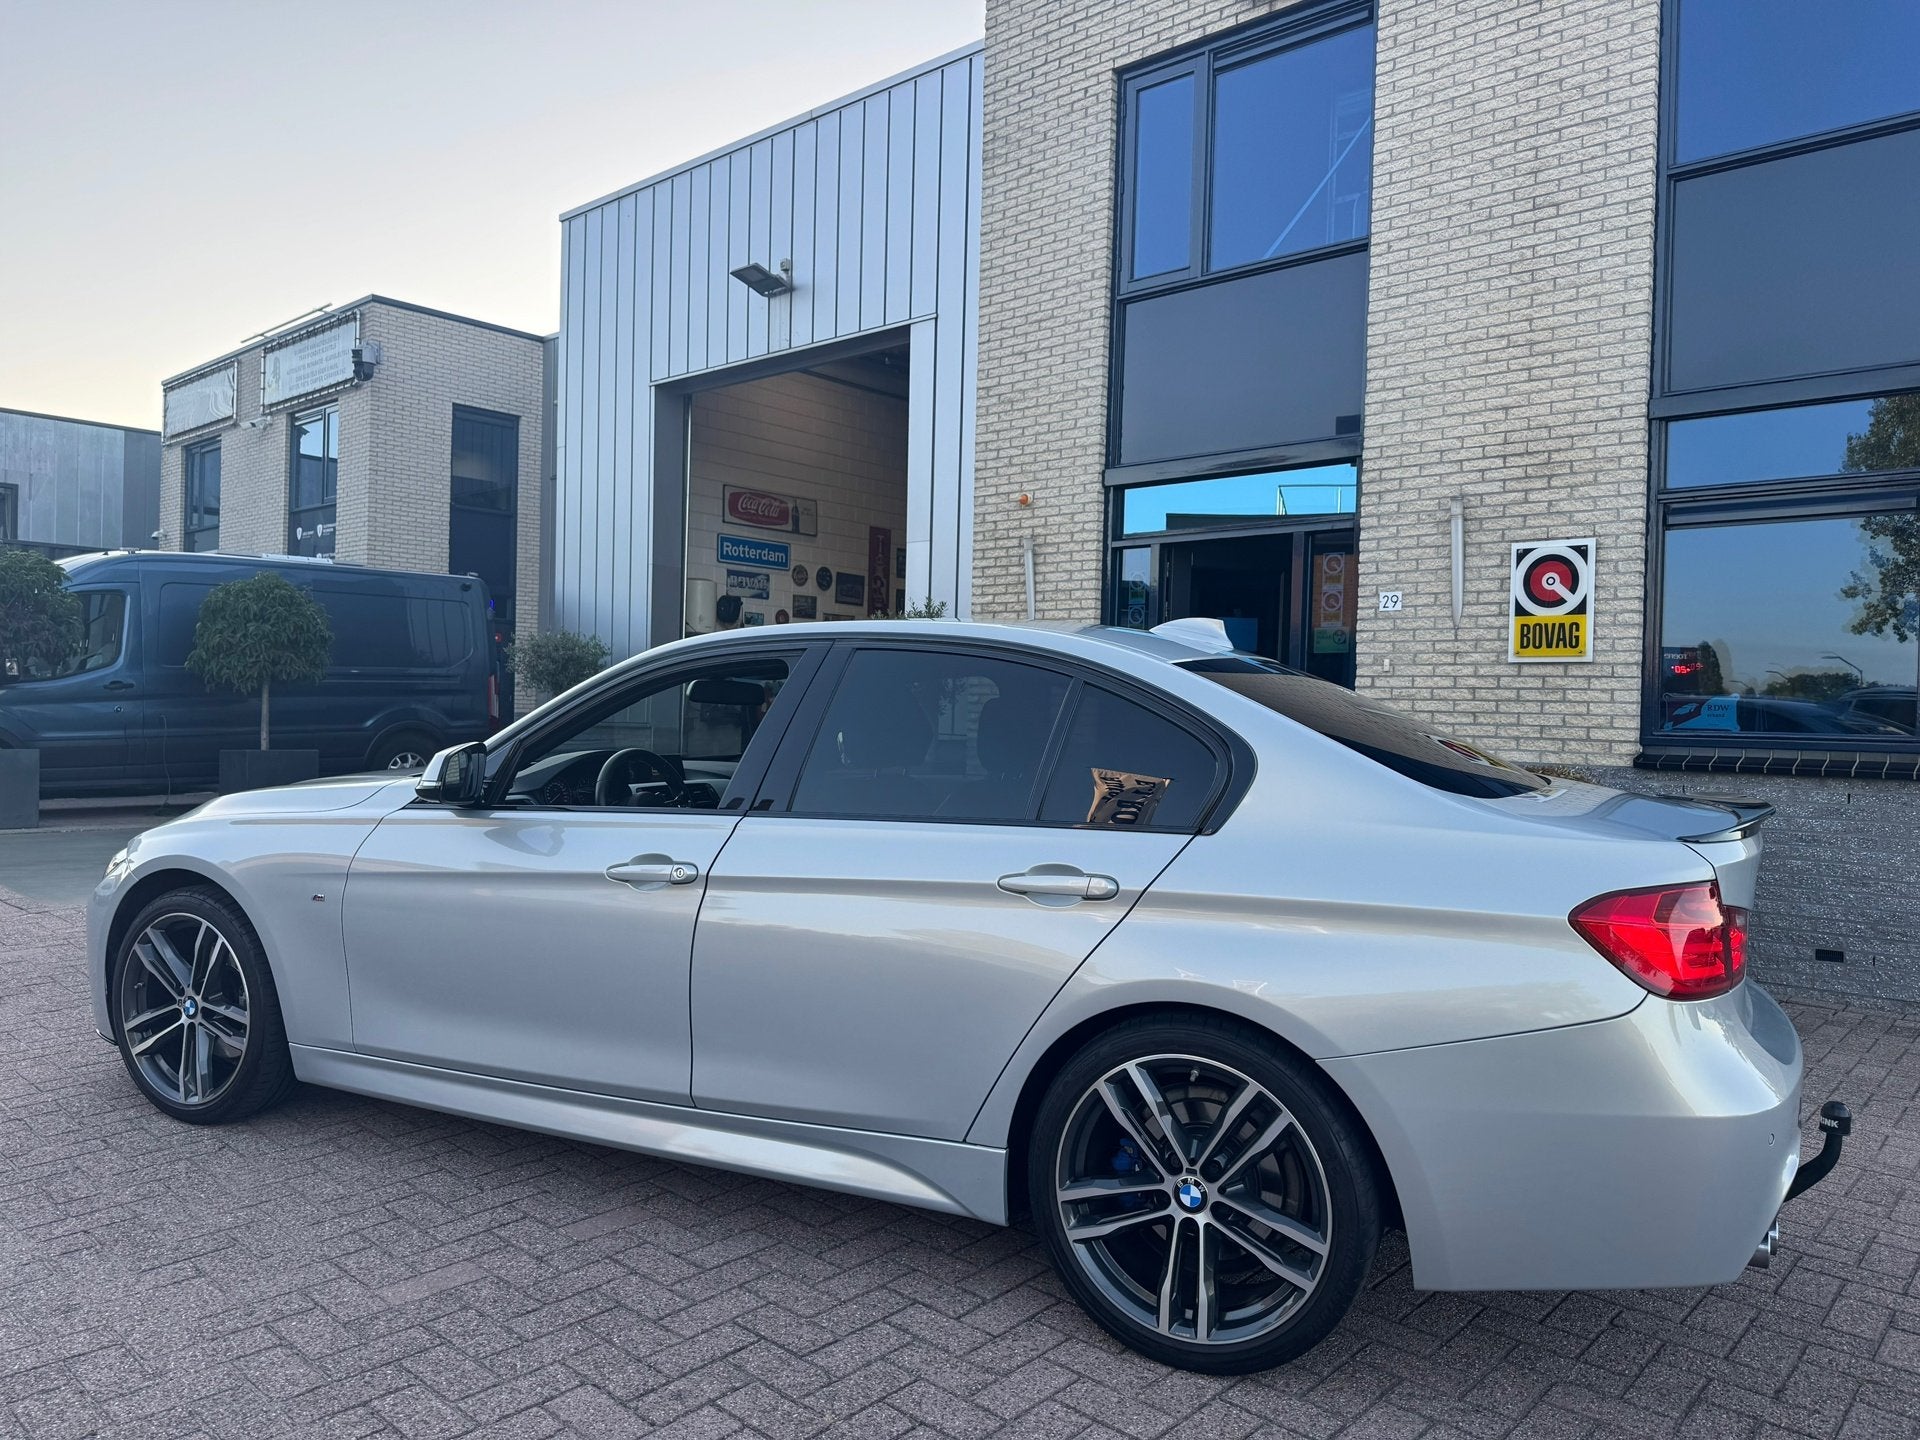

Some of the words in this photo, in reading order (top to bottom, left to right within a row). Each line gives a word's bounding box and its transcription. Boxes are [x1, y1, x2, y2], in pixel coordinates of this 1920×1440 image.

[723, 542, 786, 563] Rotterdam
[1382, 594, 1399, 609] 29
[1520, 621, 1580, 650] BOVAG
[1707, 704, 1731, 712] RDW
[1176, 1177, 1206, 1193] BMW
